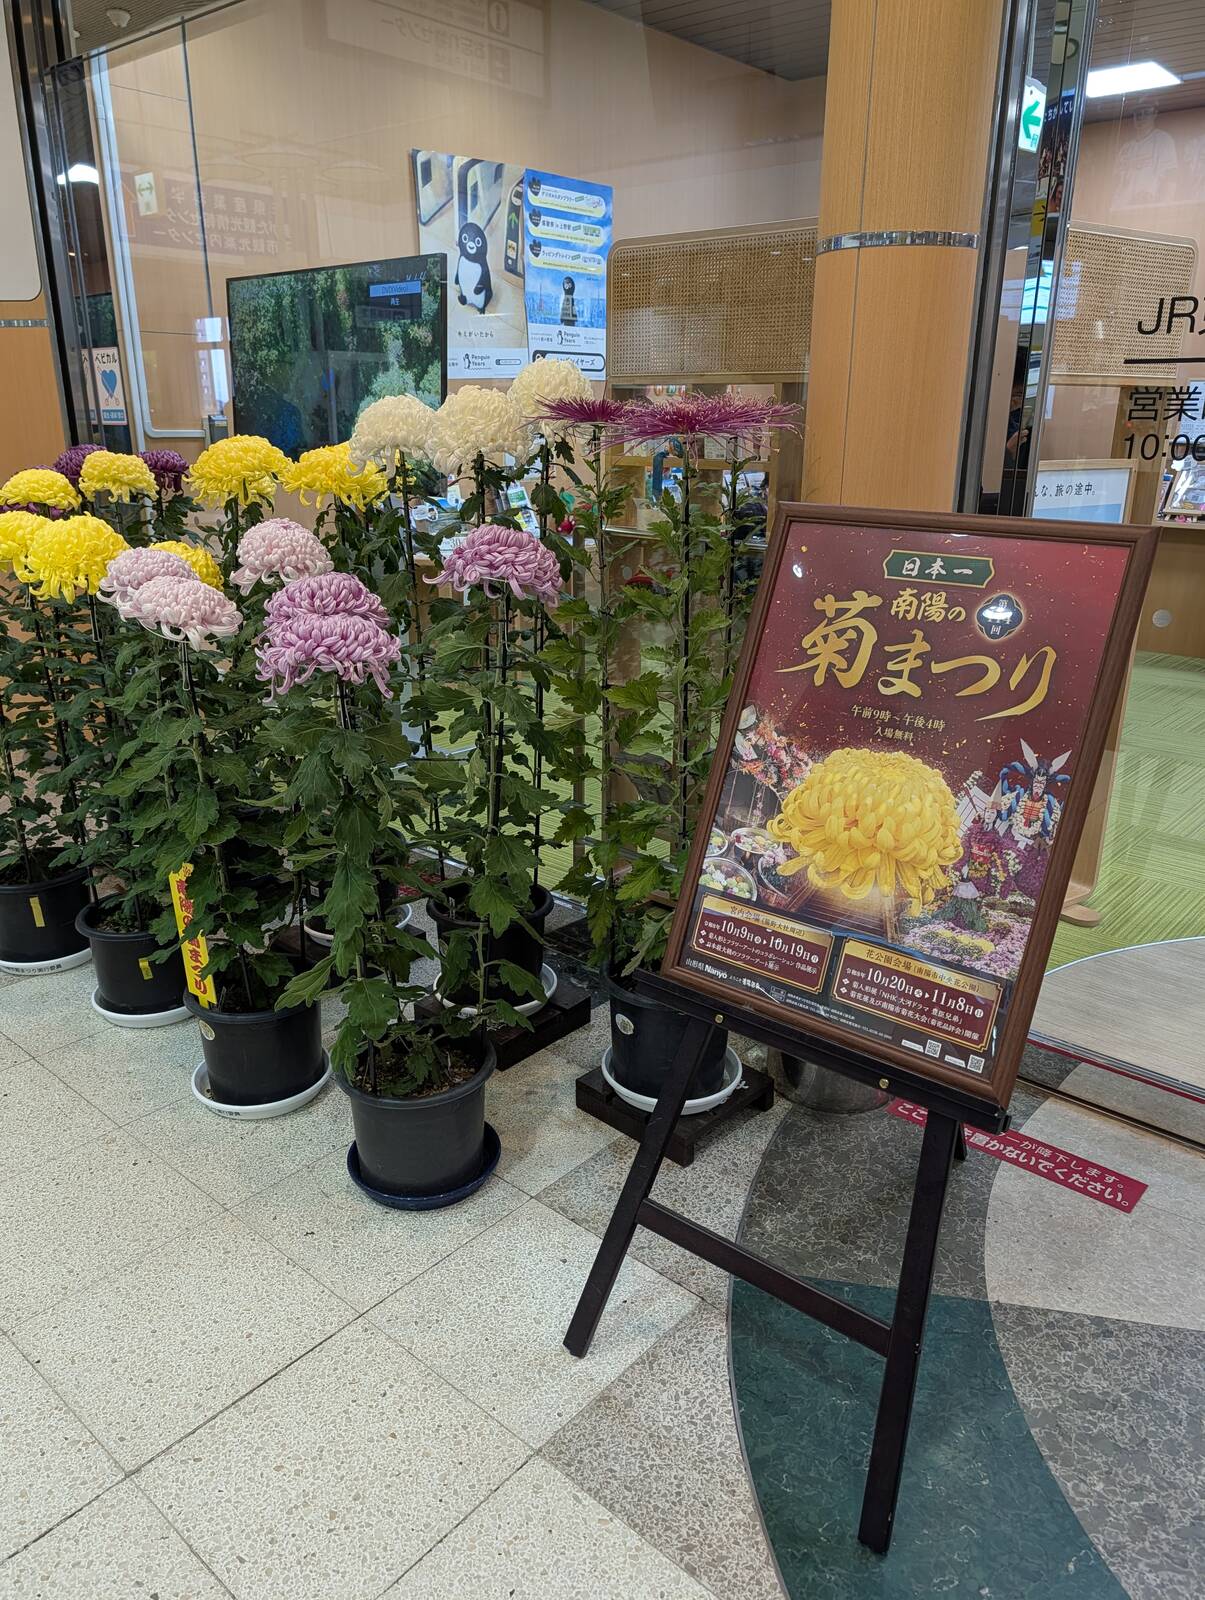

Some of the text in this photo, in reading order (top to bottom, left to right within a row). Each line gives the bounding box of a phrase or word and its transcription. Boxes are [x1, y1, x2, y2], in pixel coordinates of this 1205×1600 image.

[1137, 295, 1205, 336] JR
[1128, 385, 1205, 422] 営業
[901, 556, 974, 580] 日本一
[890, 587, 966, 623] 南陽の
[774, 590, 1057, 722] 菊まつり
[874, 727, 914, 743] 入場無料
